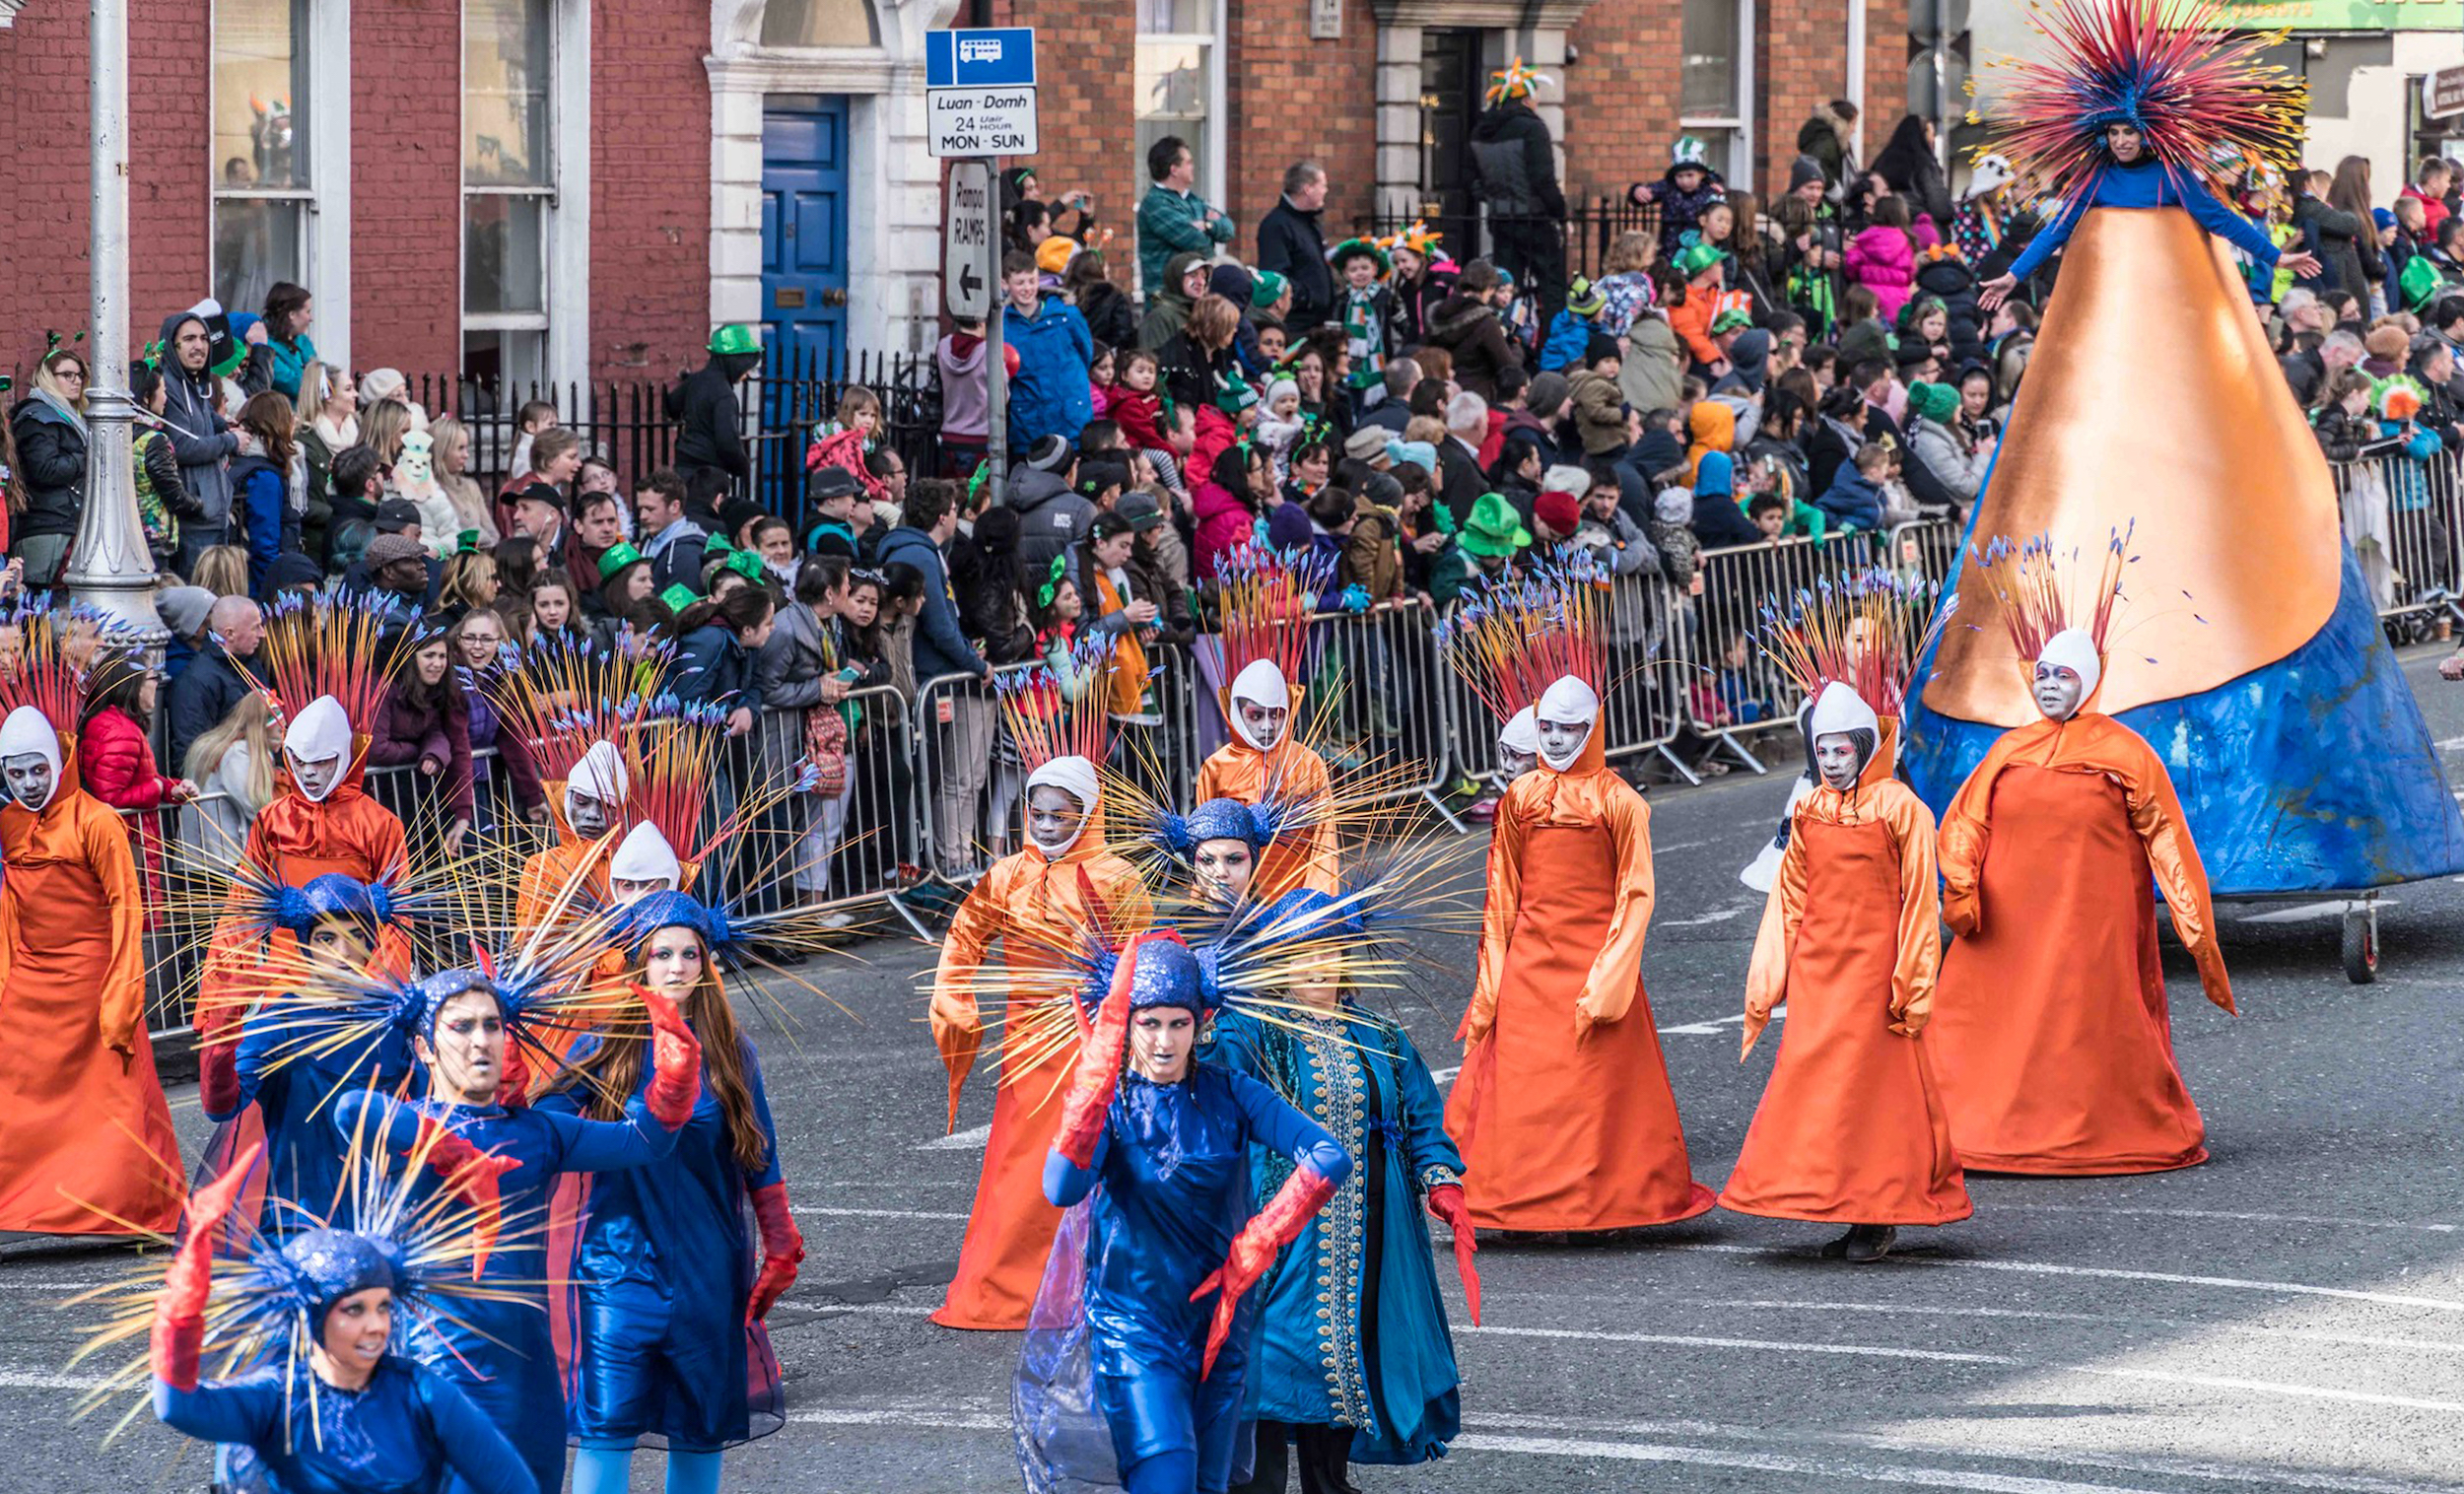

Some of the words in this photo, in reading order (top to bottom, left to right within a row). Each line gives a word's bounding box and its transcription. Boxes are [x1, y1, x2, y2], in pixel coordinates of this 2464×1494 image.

[937, 96, 973, 110] Luan
[984, 95, 1027, 108] Domh
[955, 116, 975, 132] 24
[941, 135, 980, 150] MON
[992, 134, 1025, 148] SUN
[954, 217, 985, 246] RAMPS
